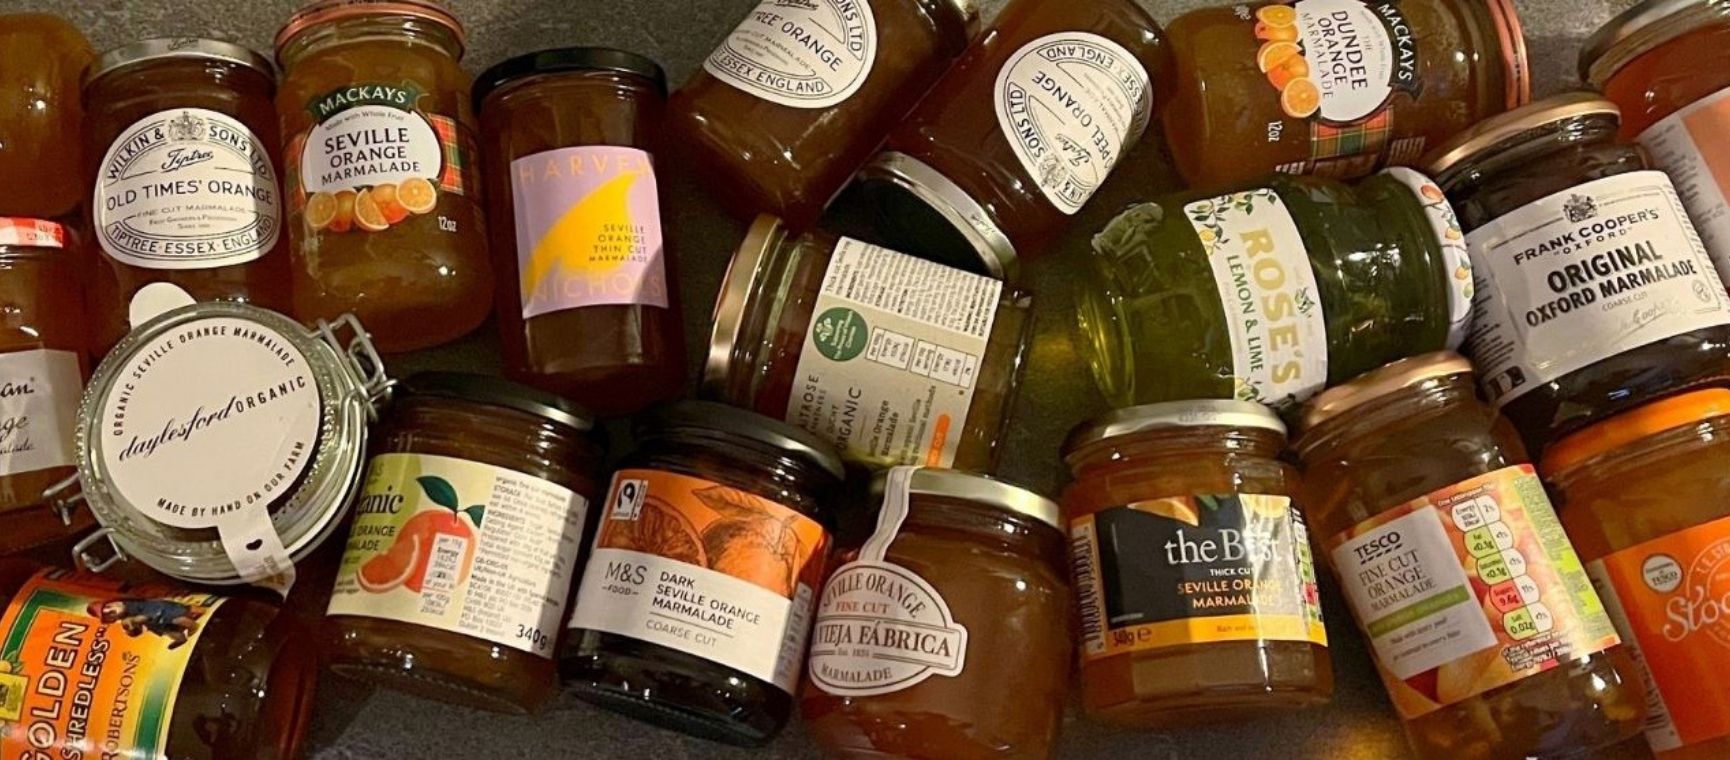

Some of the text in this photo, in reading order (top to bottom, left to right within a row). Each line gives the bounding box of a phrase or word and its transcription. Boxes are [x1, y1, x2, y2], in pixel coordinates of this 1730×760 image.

[781, 21, 843, 72] ORANGE
[849, 26, 864, 52] LTD
[1317, 17, 1348, 87] ORANGE
[1332, 10, 1368, 90] DUNDEE
[1377, 4, 1415, 82] MACKAYS
[1046, 45, 1115, 68] ENGLAND
[1301, 13, 1334, 99] MARMALADE
[721, 56, 825, 93] ESSEX ENGLAND
[318, 86, 407, 116] MACKAYS
[361, 109, 387, 119] Whole
[1010, 90, 1024, 114] LTD
[1031, 70, 1093, 128] ORANGE
[324, 127, 410, 155] SEVILLE
[1018, 117, 1047, 158] SONS
[1090, 125, 1111, 161] PEEL
[1268, 120, 1283, 143] 12oz
[107, 125, 269, 180] WILKIN & SONS LTD
[161, 148, 215, 173] Tiptree
[330, 145, 407, 169] ORANGE
[321, 160, 422, 187] MARMALADE
[106, 179, 273, 211] OLD TIMES' ORANGE
[160, 205, 182, 214] CUT
[111, 225, 160, 254] TIPTREE
[163, 241, 216, 255] ESSEX
[222, 217, 273, 251] ENGLAND
[437, 215, 458, 233] 12oz
[597, 234, 646, 244] ORANGE
[602, 223, 646, 234] SEVILLE
[1512, 207, 1660, 266] FRANK COOPER'S
[588, 254, 648, 263] MARMALADE
[593, 245, 647, 255] THIN CUT
[1546, 239, 1664, 294] ORIGINAL
[1238, 227, 1304, 385] ROSE'S
[1525, 286, 1597, 328] OXFORD
[1599, 258, 1698, 299] MARMALADE
[1601, 296, 1633, 313] COARSE
[1226, 254, 1264, 373] LEMON & LIME
[113, 325, 296, 437] ORGANIC SEVILLE ORANGE MARMALADE
[118, 375, 307, 462] daylesford ORGANIC
[833, 386, 862, 451] ORGANIC
[872, 399, 889, 435] Orange
[156, 440, 306, 518] MADE BY HAND ON OUR FARM
[437, 546, 460, 557] Energy
[1164, 528, 1217, 566] the
[1353, 531, 1401, 560] TESCO
[604, 560, 649, 586] M&S
[659, 570, 696, 589] DARK
[1209, 567, 1237, 577] THICK
[1358, 549, 1419, 587] FINE CUT
[1367, 564, 1426, 600] ORANGE
[865, 572, 926, 618] ORANGE
[1177, 578, 1229, 595] SEVILLE
[1370, 577, 1437, 612] MARMALADE
[651, 597, 736, 630] MARMALADE
[655, 583, 762, 625] SEVILLE ORANGE
[835, 602, 891, 614] FINE CUT
[516, 623, 549, 650] 340g
[645, 618, 718, 648] COARSE CUT
[857, 620, 952, 658] FÁBRICA
[1113, 628, 1136, 647] 340g
[1510, 622, 1536, 635] 0.02g
[821, 663, 893, 683] MARMALADE
